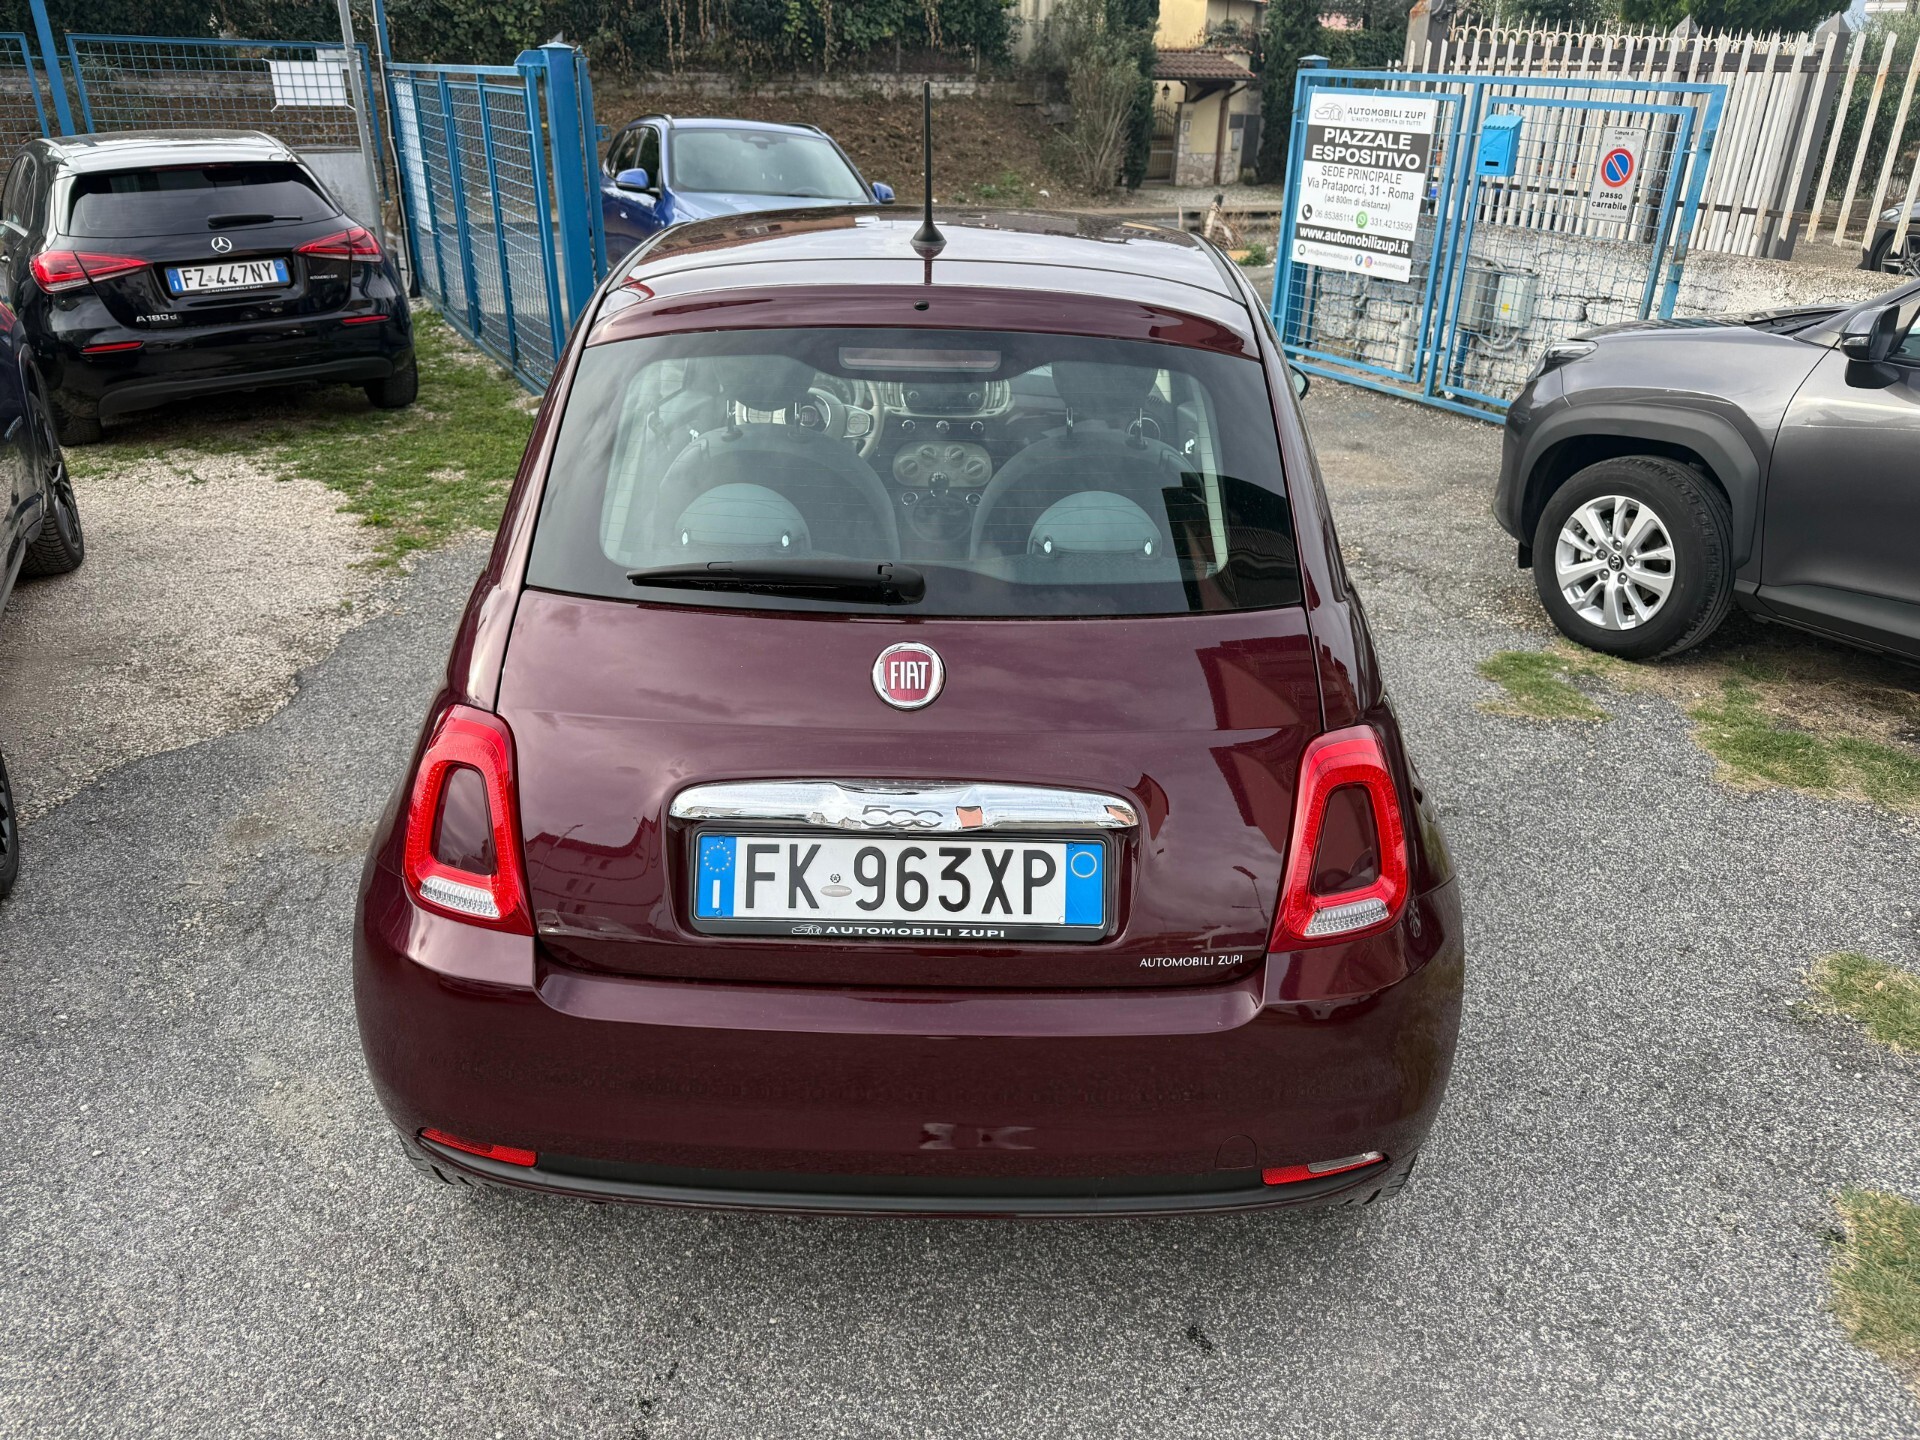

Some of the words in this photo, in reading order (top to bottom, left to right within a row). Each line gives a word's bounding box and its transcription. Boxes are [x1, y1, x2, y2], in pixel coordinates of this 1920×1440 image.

[1347, 107, 1402, 118] AUTOMOBILI
[1404, 111, 1427, 120] ZUPI
[1323, 127, 1412, 150] PIAZZALE
[1311, 144, 1421, 170] ESPOSITIVO
[1321, 165, 1345, 179] SEDE
[1347, 168, 1403, 185] PRINCIPALE
[1307, 177, 1320, 189] Via
[1321, 178, 1367, 196] Prataporci,
[1369, 185, 1379, 196] 31
[1387, 187, 1414, 200] Roma
[1600, 191, 1623, 199] passo
[1324, 193, 1335, 204] (ad
[1336, 195, 1352, 205] 800m
[1354, 197, 1360, 206] di
[1361, 199, 1391, 212] distanza)
[1591, 201, 1627, 210] carrabile
[1299, 226, 1409, 255] www.automobilizupi.it
[181, 268, 209, 288] FZ
[216, 262, 272, 286] 447NY
[890, 661, 929, 690] FIAT
[861, 804, 944, 828] 500
[744, 843, 822, 910] FK
[853, 846, 1057, 915] 963XP
[825, 926, 952, 937] AUTOMOBILI
[958, 929, 1005, 938] ZUPI
[1139, 956, 1214, 968] AUTOMOBILI
[1217, 954, 1243, 966] ZUPI
